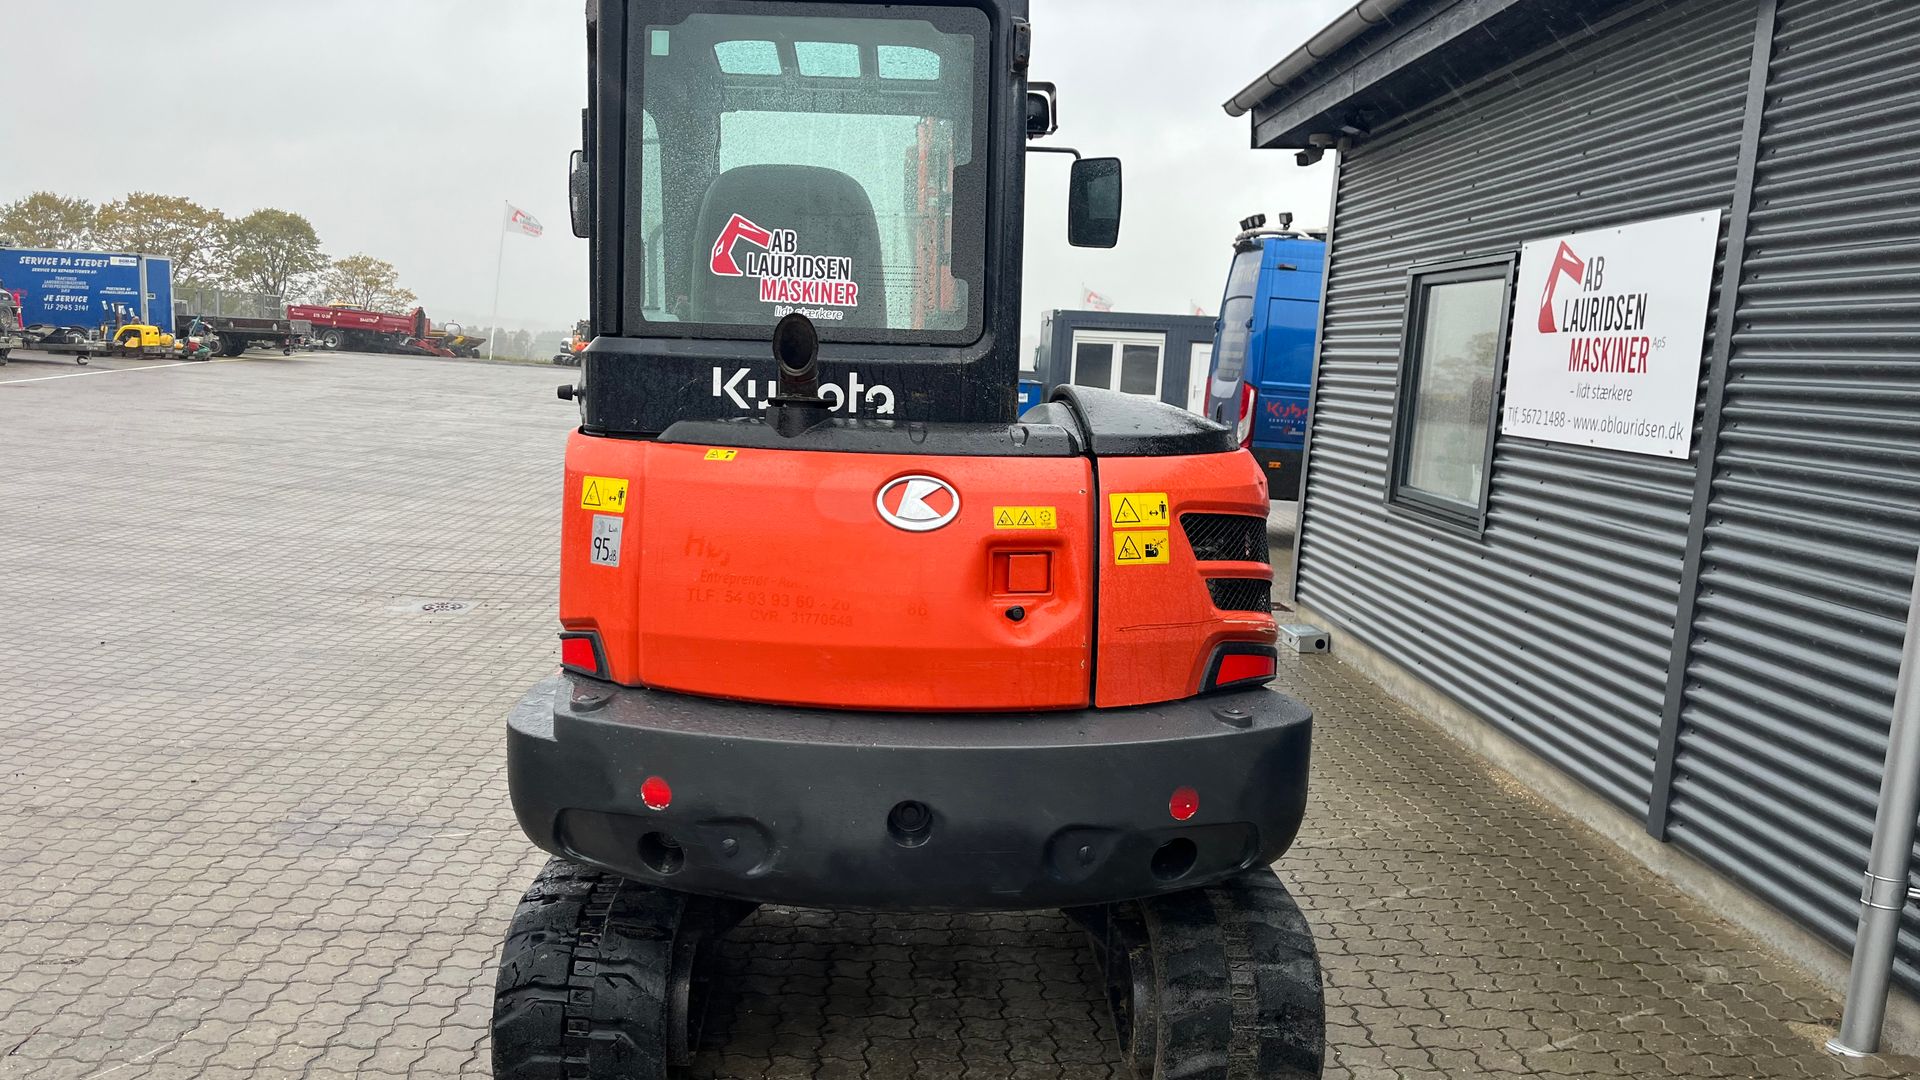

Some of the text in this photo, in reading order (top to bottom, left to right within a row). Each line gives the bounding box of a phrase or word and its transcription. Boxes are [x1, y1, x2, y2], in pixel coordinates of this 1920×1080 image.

[770, 231, 796, 252] AB
[19, 256, 110, 268] SERVICE PÅ STEDET
[747, 254, 850, 280] LAURIDSEN
[1584, 256, 1605, 292] AB
[43, 294, 89, 303] JE SERVICE
[761, 279, 858, 304] MASKINER
[44, 303, 54, 311] TLF
[1562, 293, 1648, 332] LAURIDSEN
[1568, 336, 1667, 373] MASKINER ApS
[713, 367, 895, 414] Kuota
[1576, 382, 1591, 399] lidt
[1592, 384, 1633, 402] stærkere
[1521, 408, 1542, 425] 5672
[1543, 411, 1565, 428] 1488
[1573, 415, 1684, 441] www.ablauridsen.dk
[593, 536, 610, 561] 95
[748, 593, 766, 606] 93
[771, 593, 789, 608] 93
